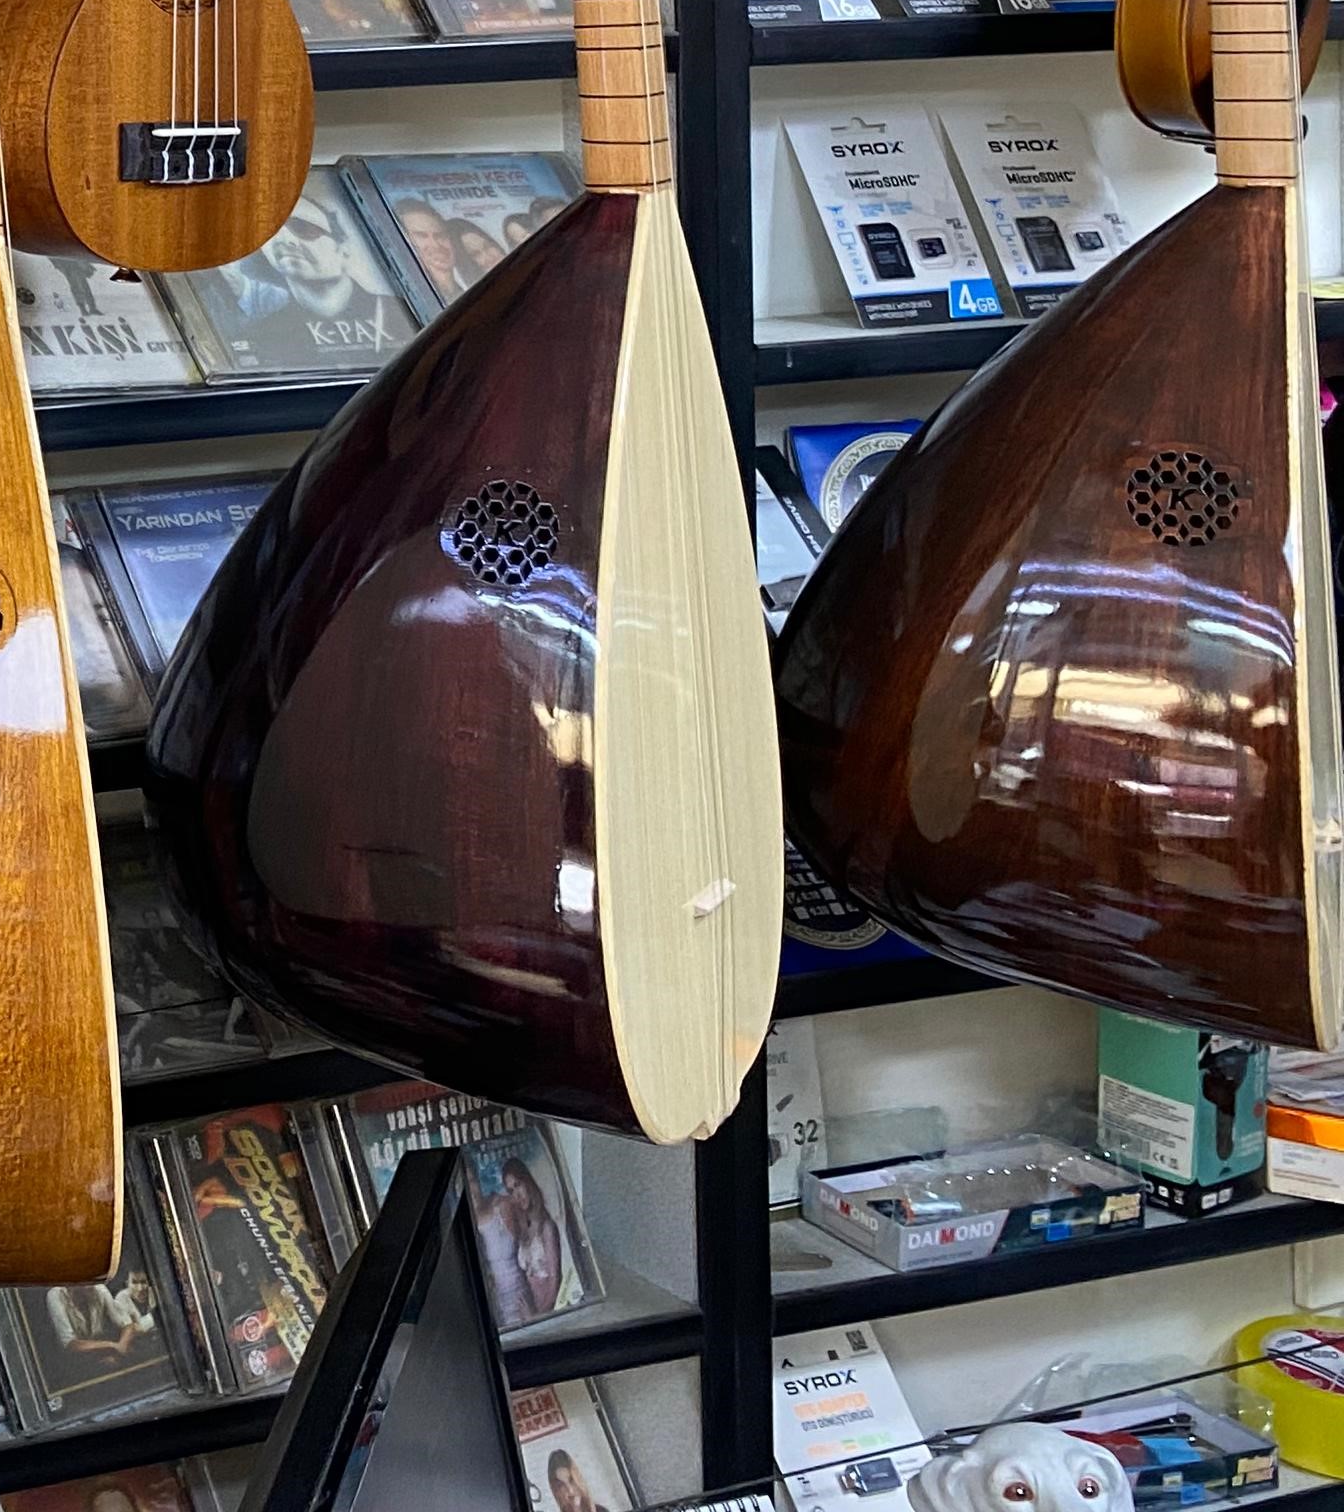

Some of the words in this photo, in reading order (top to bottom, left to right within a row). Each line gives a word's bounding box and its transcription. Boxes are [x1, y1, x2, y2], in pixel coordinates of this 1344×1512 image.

[830, 140, 906, 159] SYROX
[987, 139, 1060, 154] SYROX
[958, 283, 999, 315] 4GB
[61, 316, 145, 361] KİŞİ
[305, 295, 394, 354] K-PAX
[116, 508, 224, 533] YARINDAN
[385, 1102, 433, 1133] vahşi
[792, 1118, 819, 1146] 32
[907, 1220, 996, 1251] DAIMOND
[783, 1369, 859, 1397] SYROX
